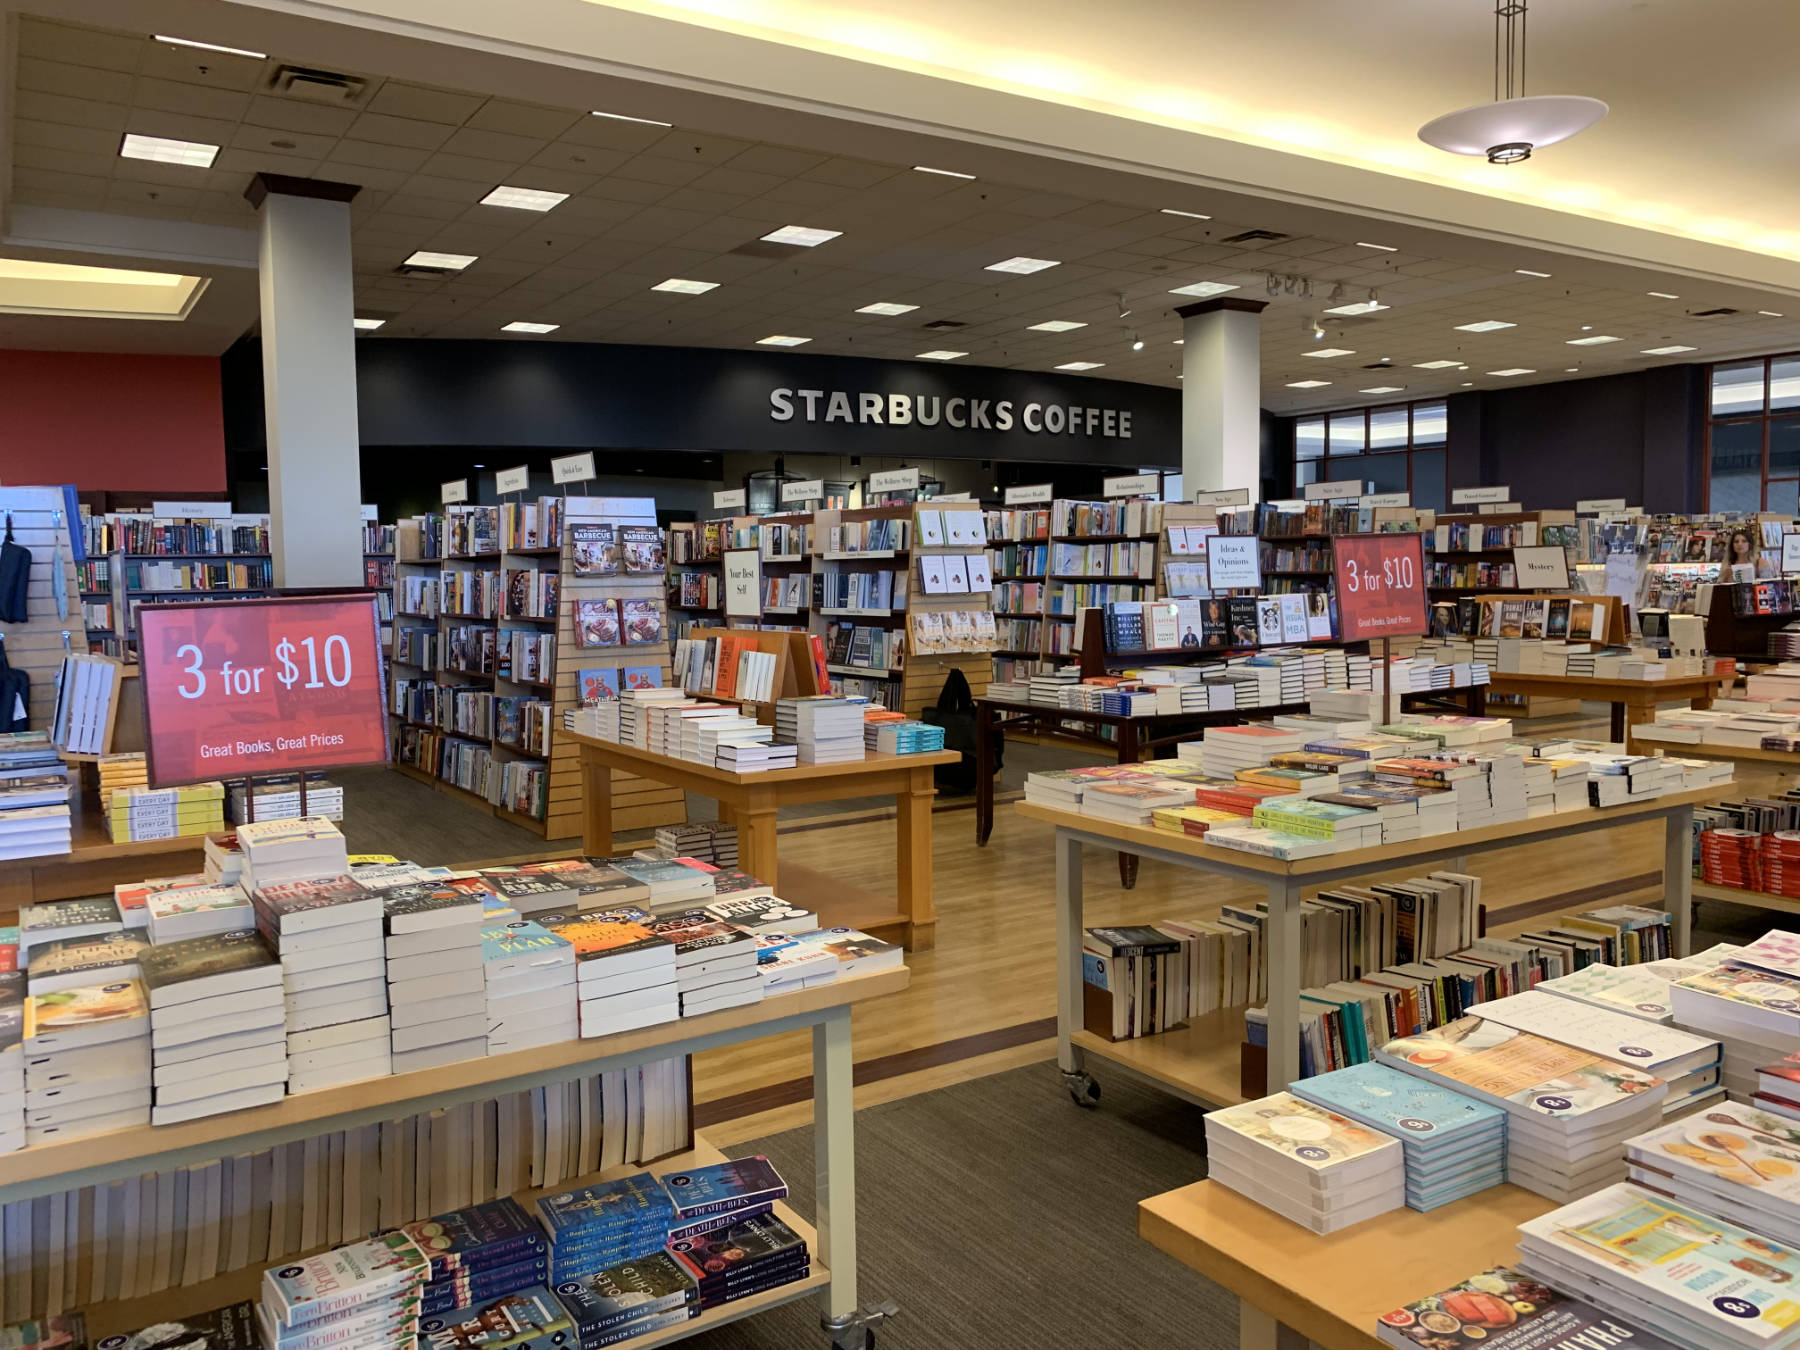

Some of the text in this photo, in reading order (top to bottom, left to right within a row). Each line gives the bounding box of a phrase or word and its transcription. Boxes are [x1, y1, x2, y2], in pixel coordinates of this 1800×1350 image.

[769, 387, 1132, 438] STARBUCKS COFFEE
[574, 531, 611, 540] BARBECUE
[1220, 544, 1246, 553] Ideas &
[1218, 557, 1249, 568] Opinions
[1527, 562, 1555, 572] Mystery
[684, 573, 698, 581] THE
[730, 567, 754, 578] Your Best
[1346, 556, 1413, 592] 3 for $10
[736, 584, 747, 595] Self
[684, 597, 700, 605] BOO
[1286, 625, 1305, 635] MBA
[176, 634, 352, 699] 3 for $10
[200, 732, 344, 759] Great Books, Great Prices
[138, 796, 170, 805] EVERY DAY
[137, 809, 156, 817] EVERY
[137, 821, 156, 829] EVERY
[500, 936, 556, 953] PLAN
[694, 1198, 749, 1216] DEATH BEES
[685, 1215, 737, 1238] DEATH BEES
[592, 1271, 630, 1308] STOLEN
[622, 1267, 654, 1295] CHILD
[317, 1292, 362, 1313] Britton
[582, 1325, 595, 1333] THE
[597, 1315, 625, 1328] STOLEN
[627, 1306, 649, 1318] CHILD
[306, 1328, 350, 1347] Britton
[584, 1323, 652, 1350] THE STOLEN CHILD
